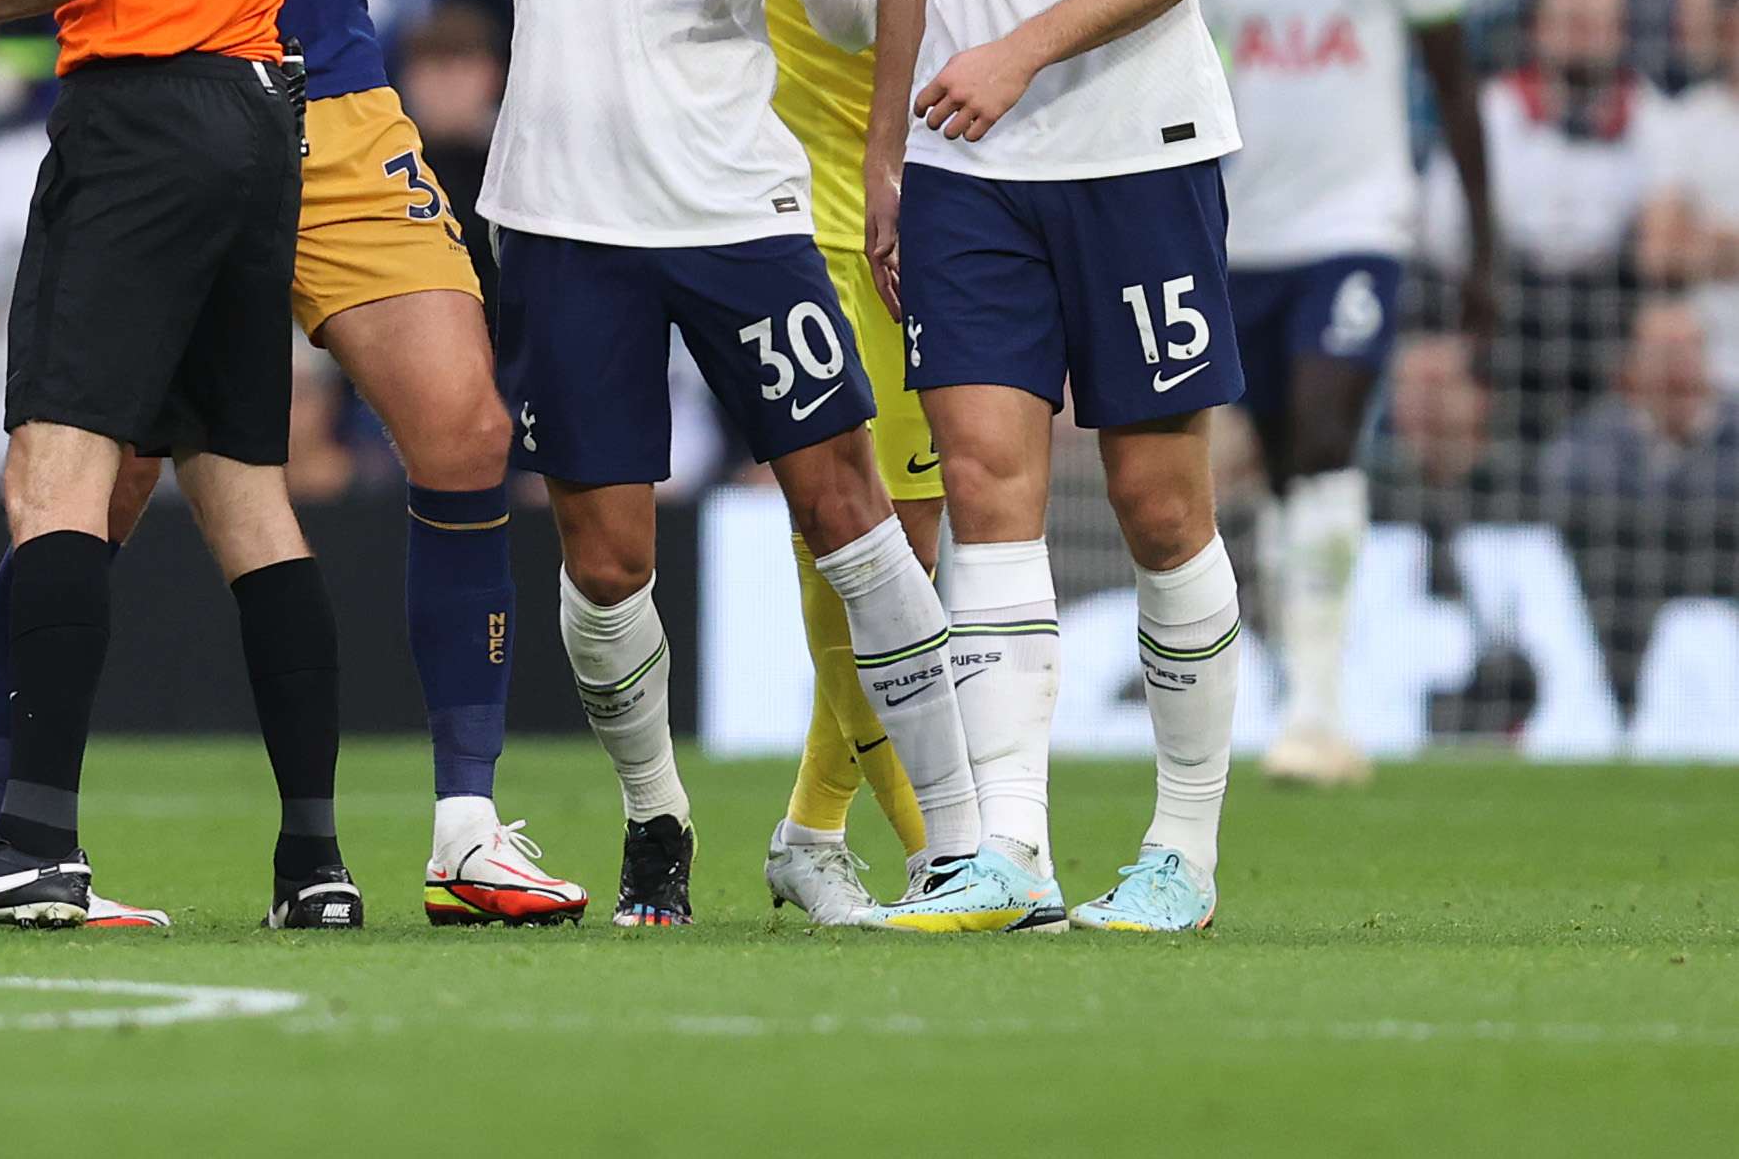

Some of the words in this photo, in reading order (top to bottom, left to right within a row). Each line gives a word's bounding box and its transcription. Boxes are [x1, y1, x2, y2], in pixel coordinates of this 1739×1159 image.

[1233, 11, 1367, 71] AIA
[382, 149, 453, 221] 3
[1122, 274, 1210, 365] 15
[738, 301, 844, 401] 30
[488, 612, 506, 664] NUFC
[950, 652, 1003, 667] PURS
[872, 664, 944, 692] SPURS
[322, 903, 351, 918] NIKE
